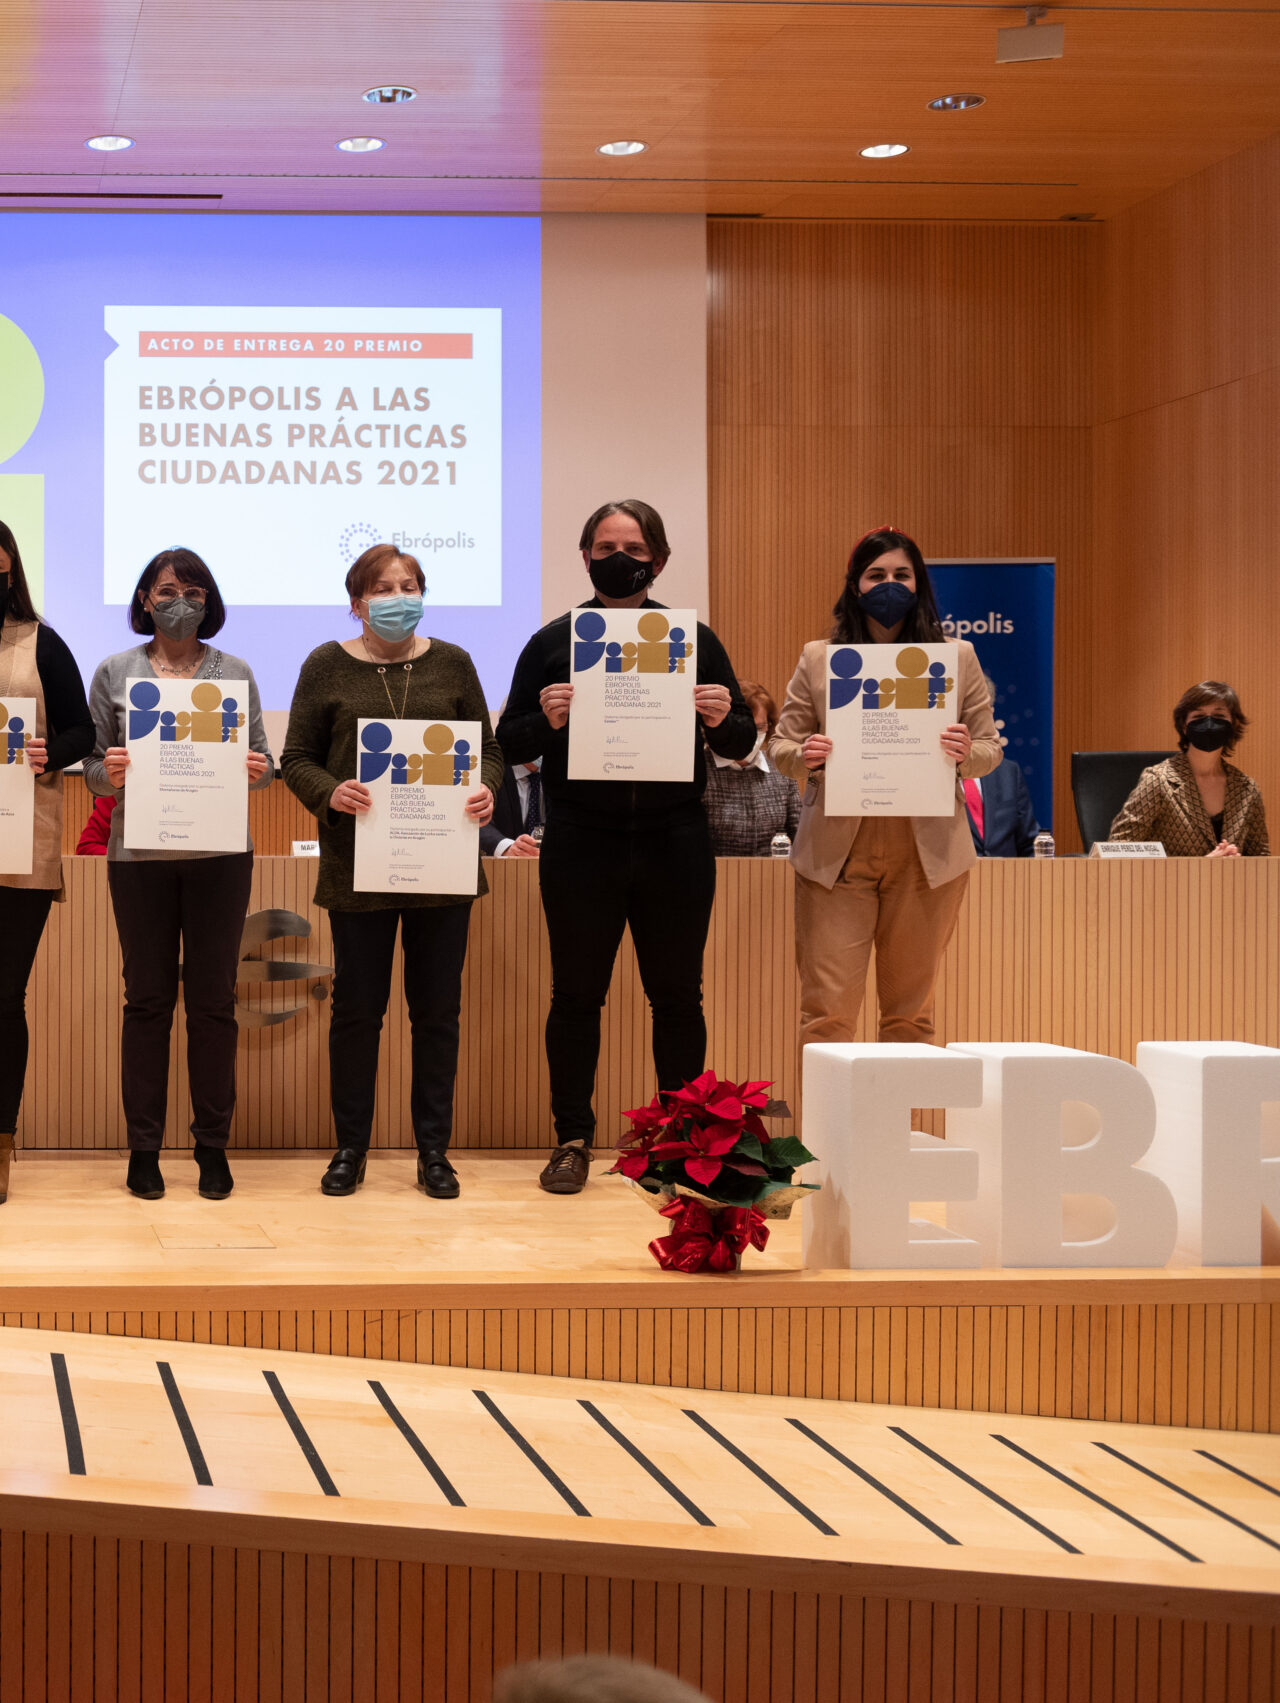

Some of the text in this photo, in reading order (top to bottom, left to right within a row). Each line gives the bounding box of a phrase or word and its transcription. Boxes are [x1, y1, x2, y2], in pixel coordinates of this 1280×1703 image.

[147, 338, 422, 351] ACTO DE ENTREGA 20 PREMIO
[139, 378, 430, 411] EBRÓPOLIS A LAS
[139, 416, 467, 448] BUENAS PRÁCTICAS
[138, 459, 456, 486] CIUDADANAS 2021
[392, 531, 475, 552] Ebrópolis
[942, 611, 1014, 640] ópolis
